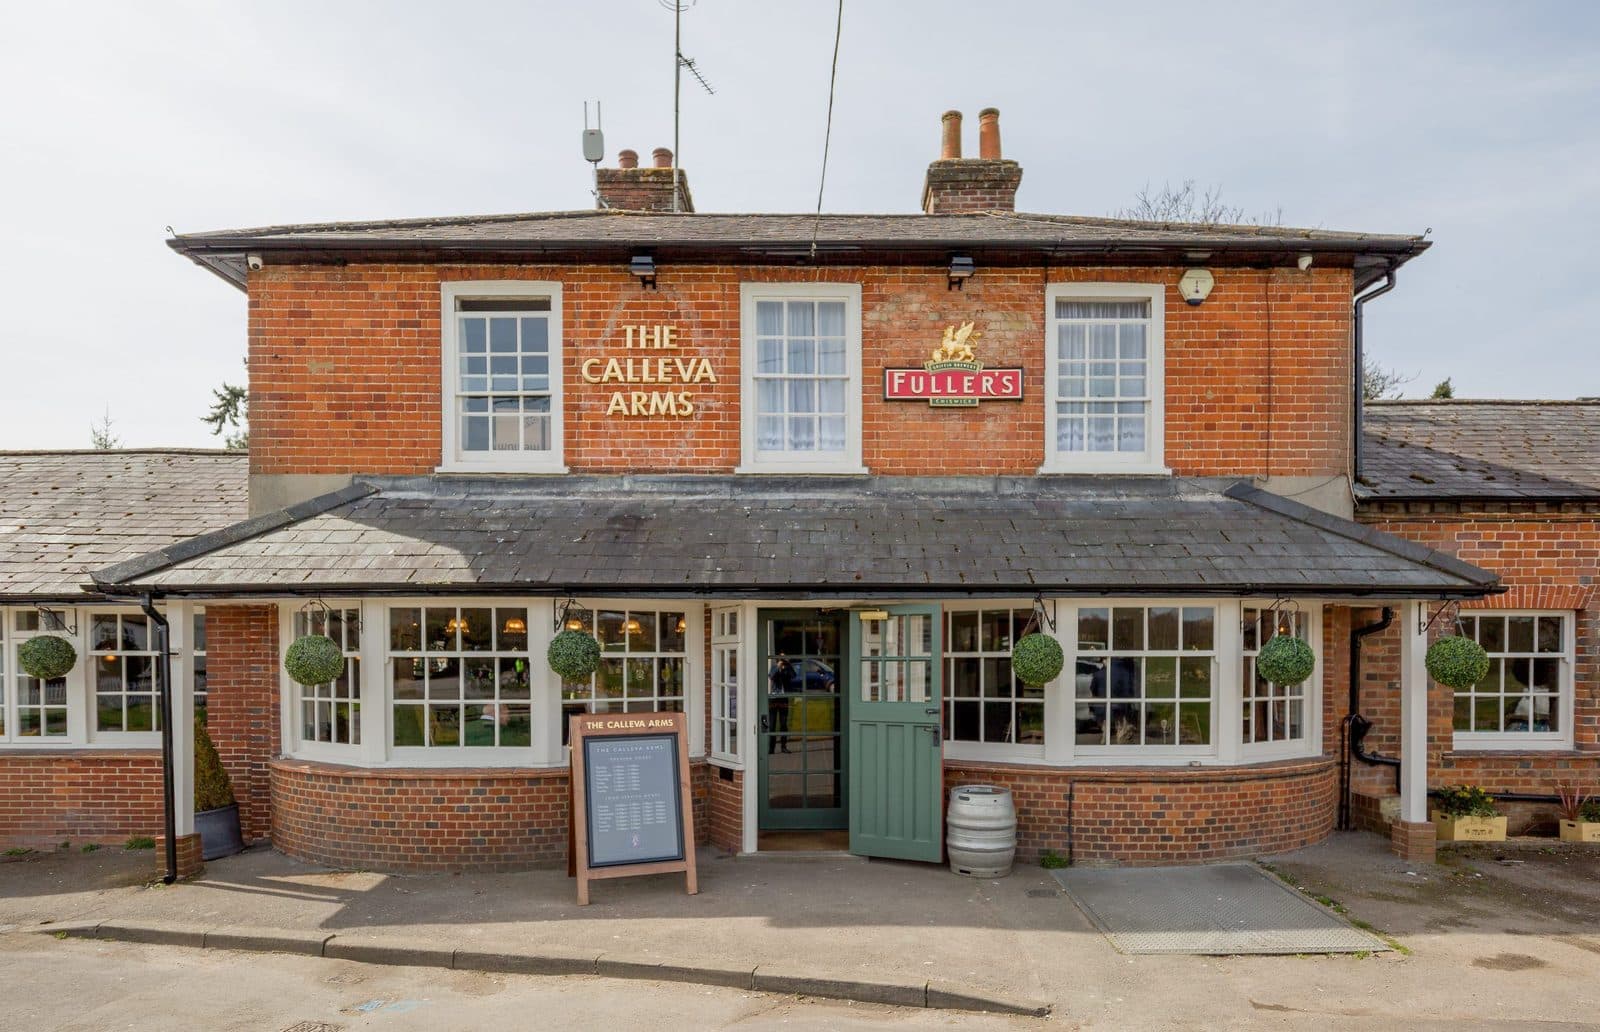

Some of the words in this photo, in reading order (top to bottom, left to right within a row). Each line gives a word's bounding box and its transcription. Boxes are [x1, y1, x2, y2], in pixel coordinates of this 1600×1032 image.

[622, 325, 678, 349] THE
[581, 358, 717, 383] CALLEVA
[953, 362, 976, 370] BREWERY
[893, 372, 1013, 395] FULLER'S
[606, 391, 694, 416] ARMS
[586, 721, 604, 729] THE
[607, 720, 646, 729] CALLEVA
[648, 719, 674, 727] ARMS
